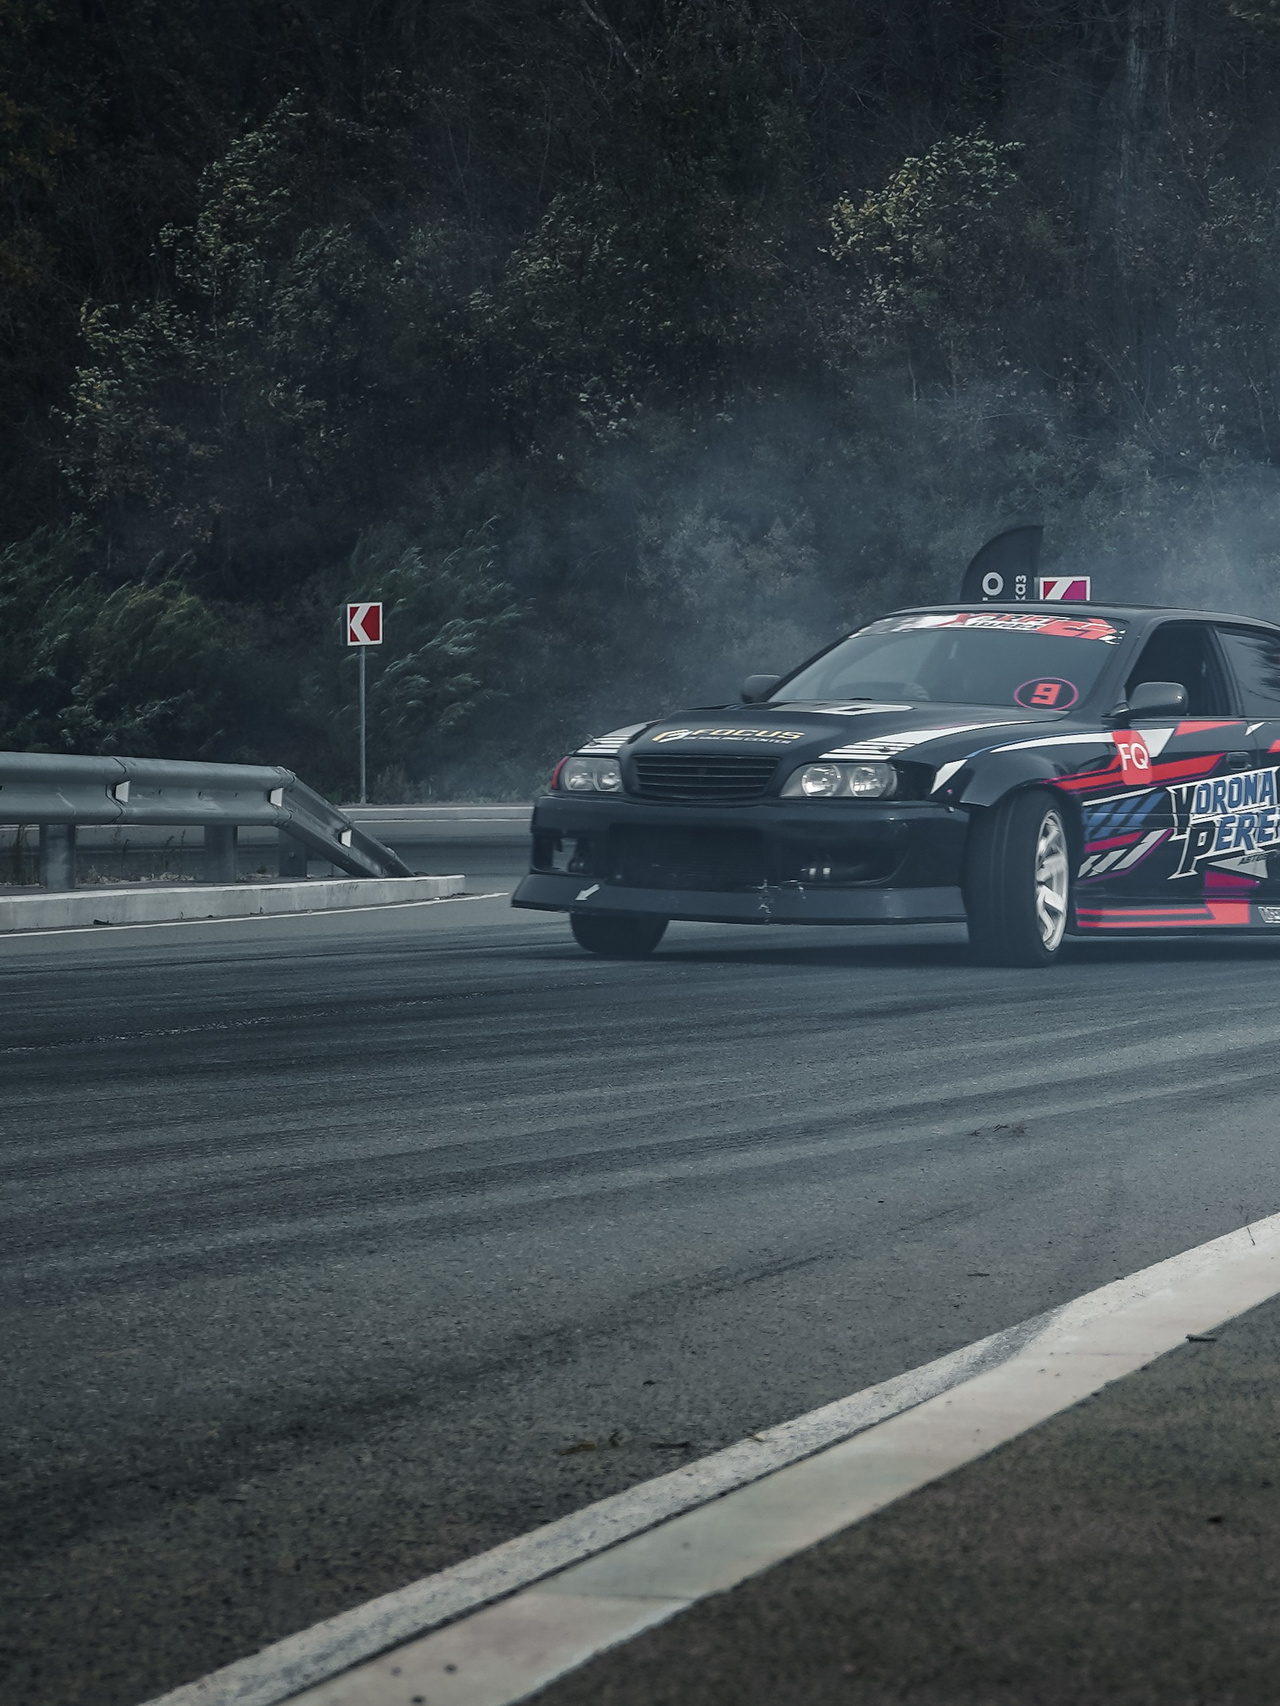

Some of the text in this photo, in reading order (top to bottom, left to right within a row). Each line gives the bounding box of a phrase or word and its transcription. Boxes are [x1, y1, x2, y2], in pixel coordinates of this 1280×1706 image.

[1030, 683, 1062, 705] 9
[692, 728, 805, 740] FOCUS
[1117, 742, 1149, 770] FQ
[1167, 767, 1280, 841] VORONA
